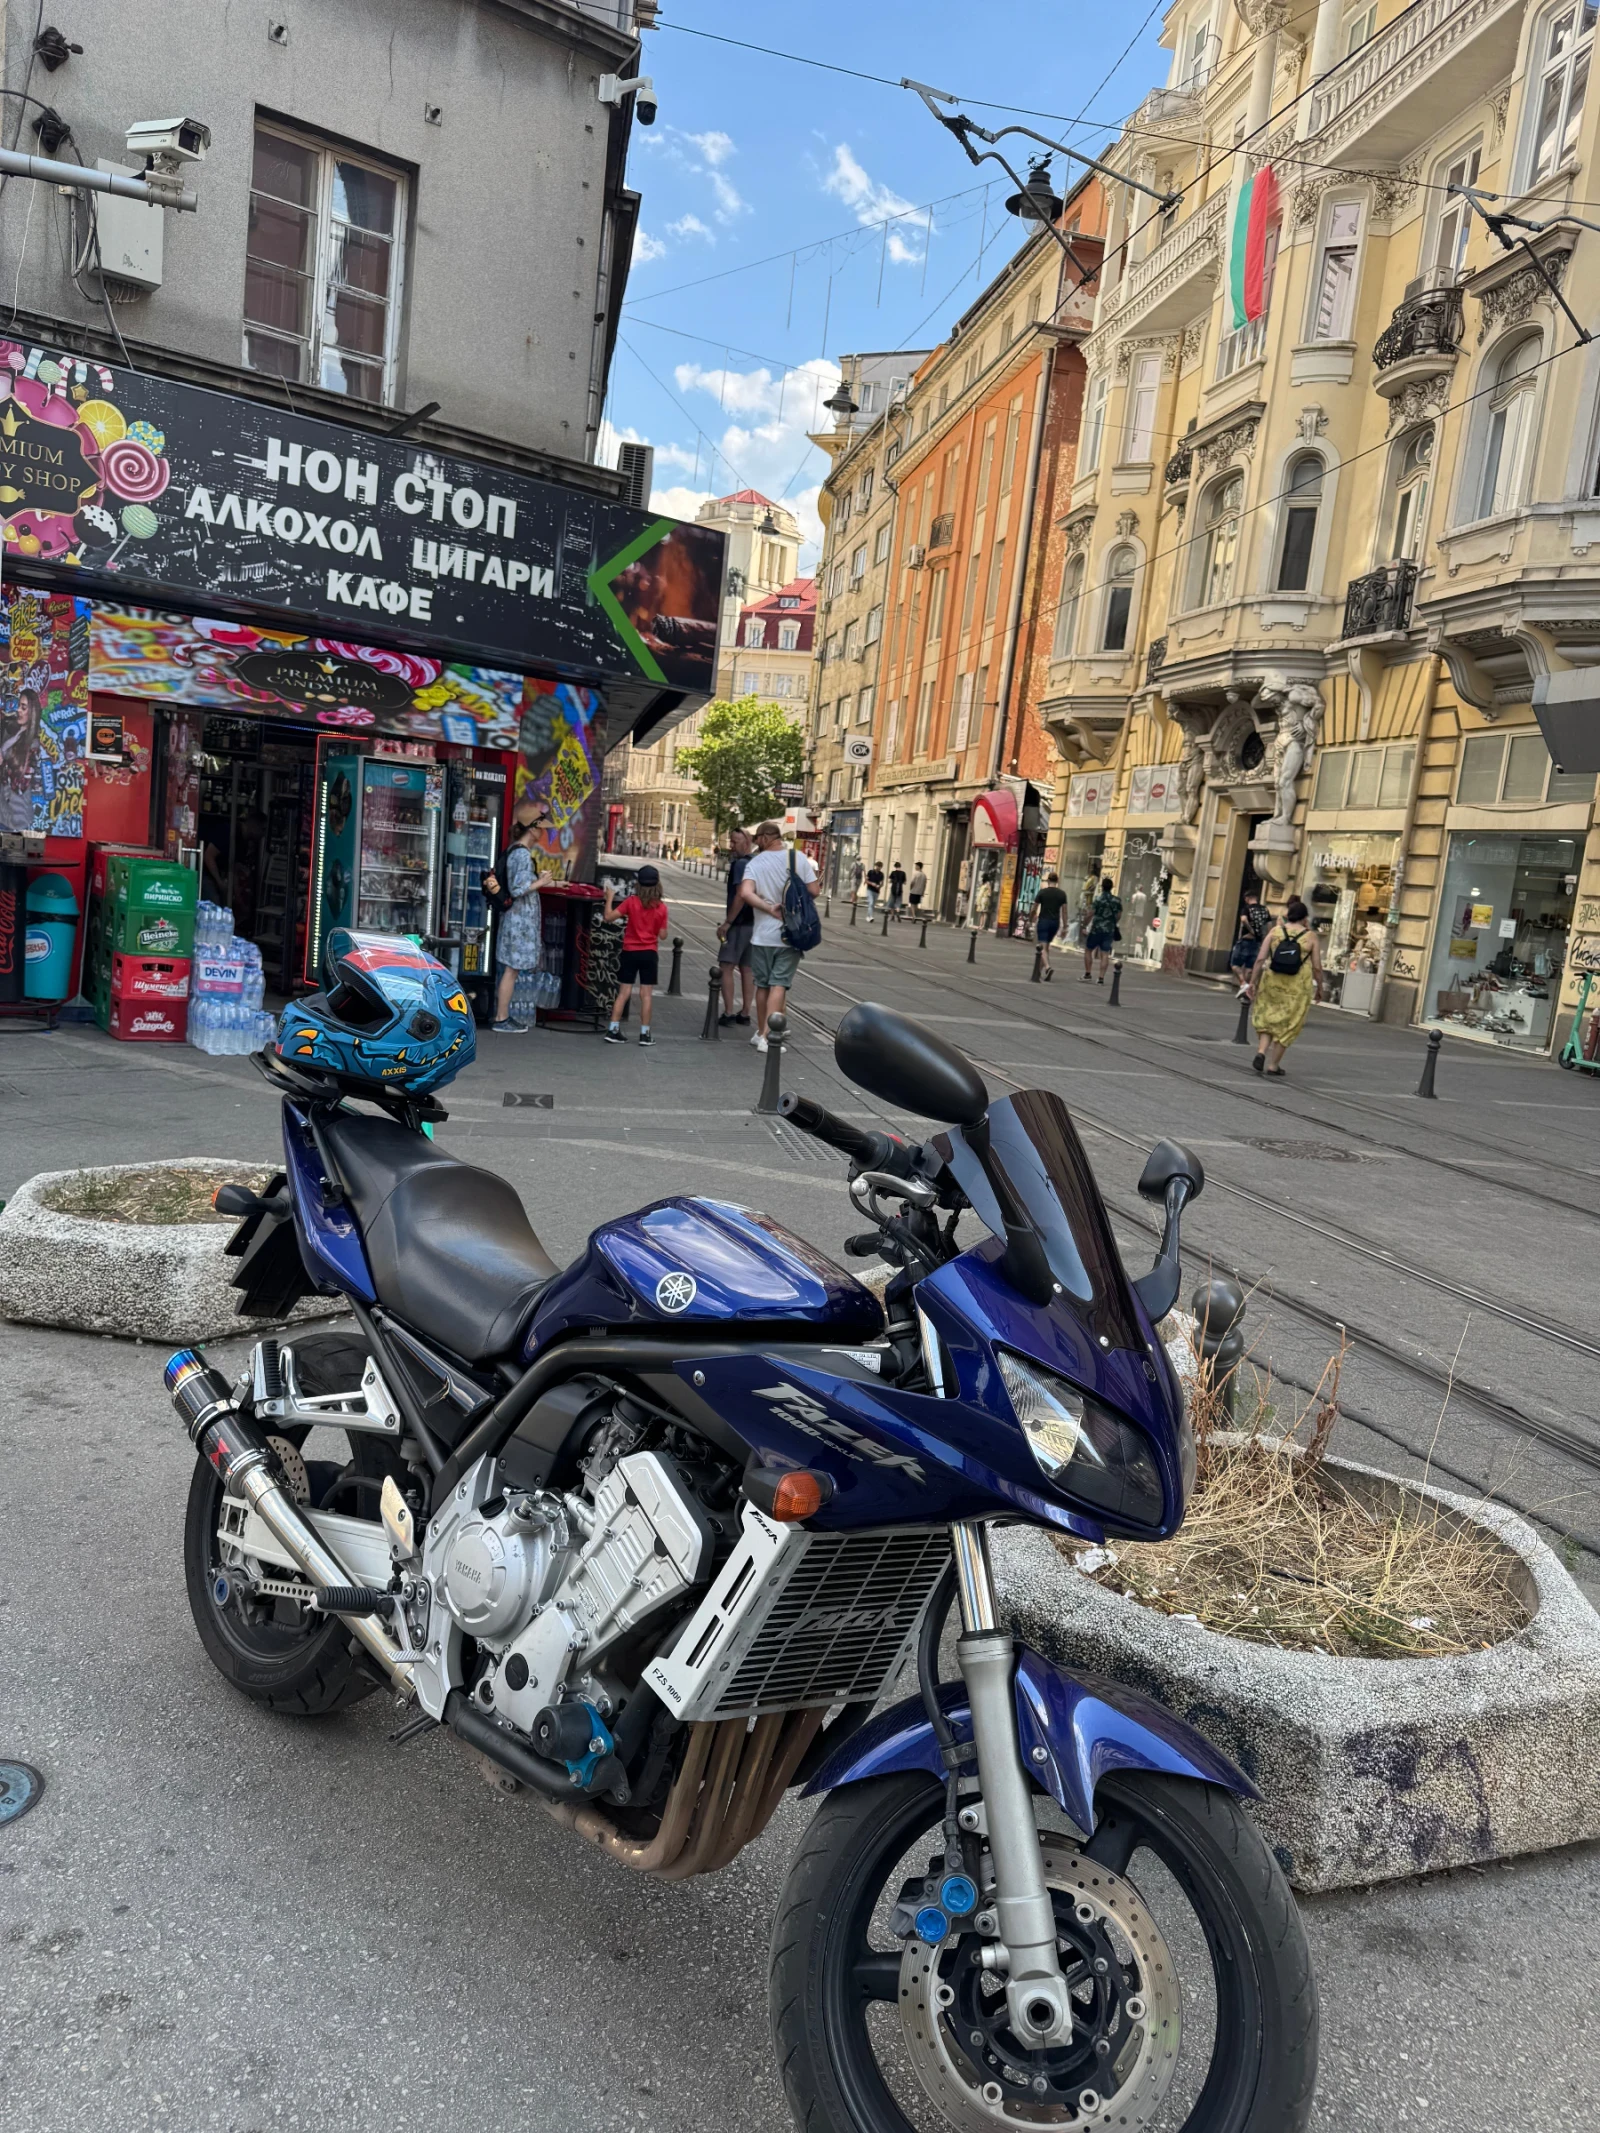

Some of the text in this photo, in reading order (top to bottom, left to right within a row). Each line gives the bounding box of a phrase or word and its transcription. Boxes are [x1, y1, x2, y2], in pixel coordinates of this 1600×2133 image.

[0, 436, 65, 467] MIUM
[22, 466, 81, 493] SHOP
[265, 437, 518, 539] НОН СТОП
[184, 486, 554, 599] АЛКОХОЛ ЦИГАРИ
[327, 568, 433, 621] КАФЕ
[102, 643, 218, 665] LOOS
[266, 675, 385, 700] CANDY SHOP
[276, 667, 378, 691] PREMIUM
[143, 930, 179, 942] Heineke
[205, 966, 237, 979] DEVIN
[382, 1066, 407, 1077] AXXIS
[751, 1381, 927, 1485] FAZER
[652, 1668, 682, 1703] FZS 1000
